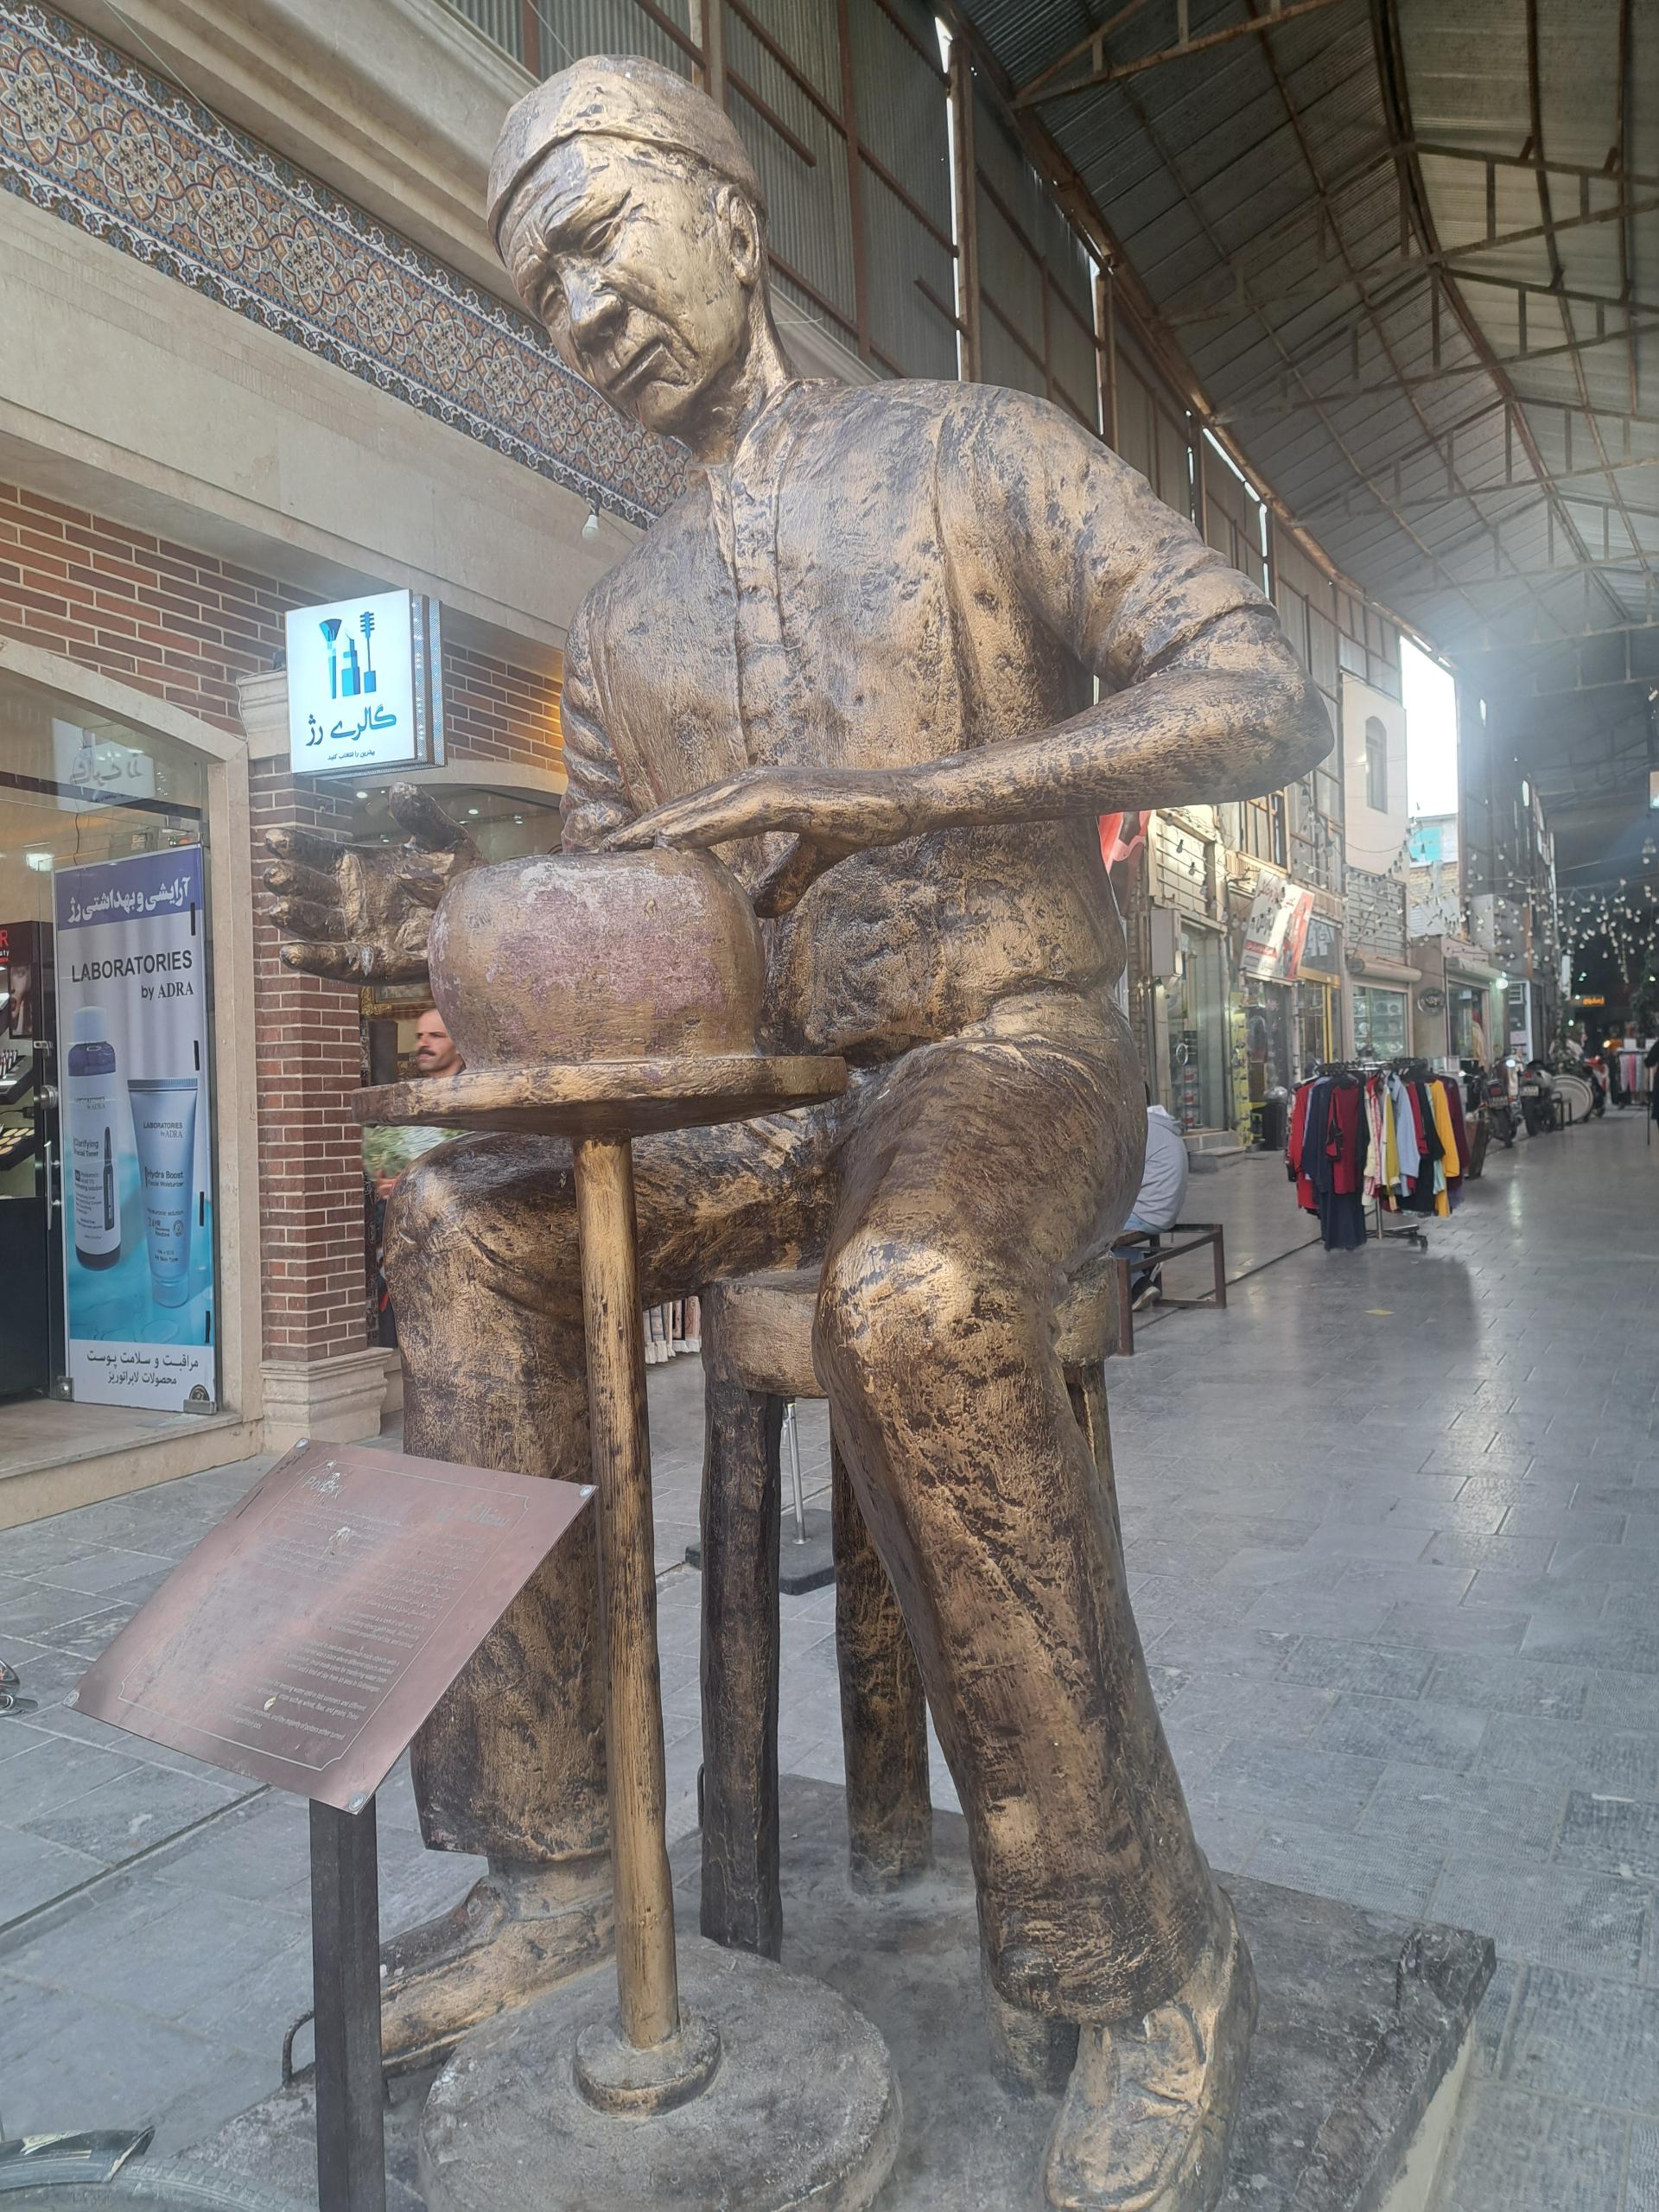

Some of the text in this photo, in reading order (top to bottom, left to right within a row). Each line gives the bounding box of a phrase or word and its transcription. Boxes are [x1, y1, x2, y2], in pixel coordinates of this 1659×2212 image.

[306, 714, 323, 746] رژ
[67, 876, 191, 923] آرایشی و بهداشتی رژ
[72, 950, 193, 982] LABORATORIES
[142, 982, 194, 1001] by ADRA
[165, 1129, 183, 1138] ADRA
[148, 1169, 183, 1179] Hydra Boost
[86, 1351, 199, 1371] مراقبت و سلامت پوست
[142, 1372, 177, 1387] محصولات
